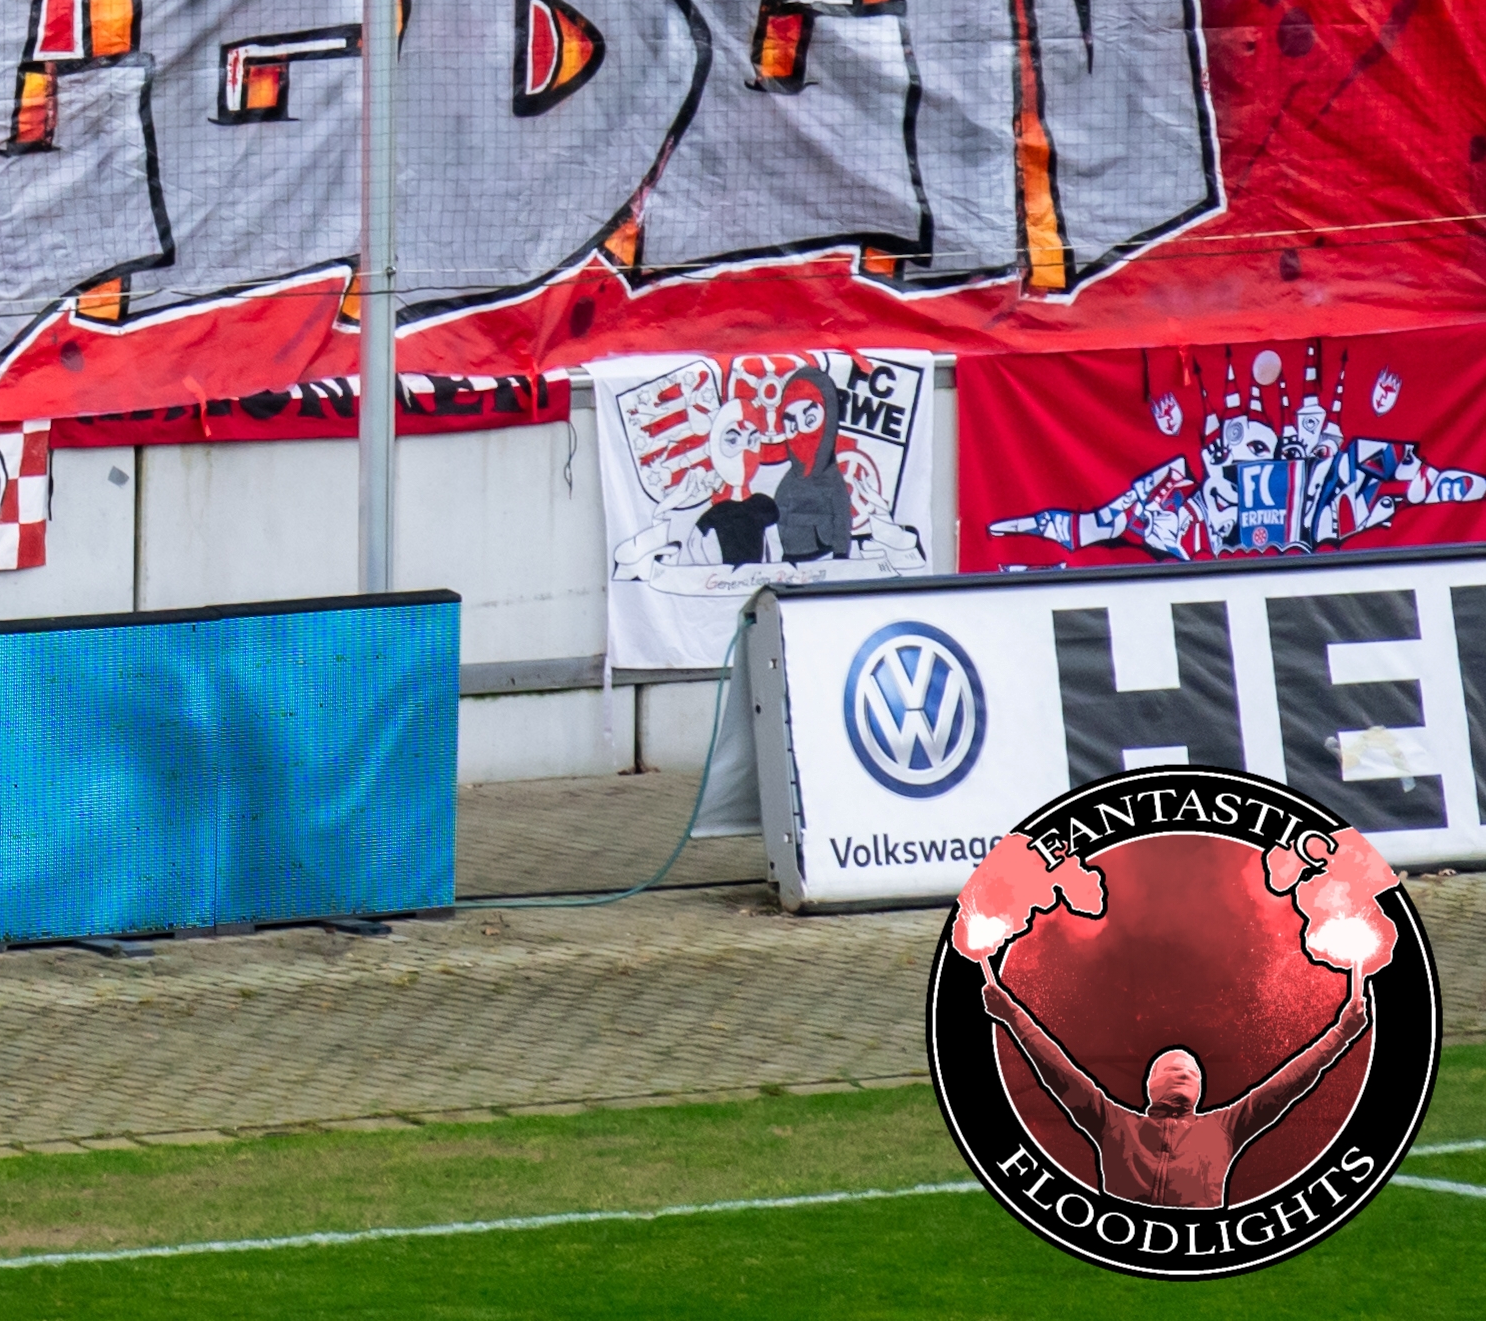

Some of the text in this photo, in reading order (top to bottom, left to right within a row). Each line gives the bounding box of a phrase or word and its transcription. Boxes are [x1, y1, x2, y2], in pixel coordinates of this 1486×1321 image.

[1243, 464, 1276, 509] FC
[1241, 509, 1287, 528] ERFURT
[1051, 584, 1486, 833] HE
